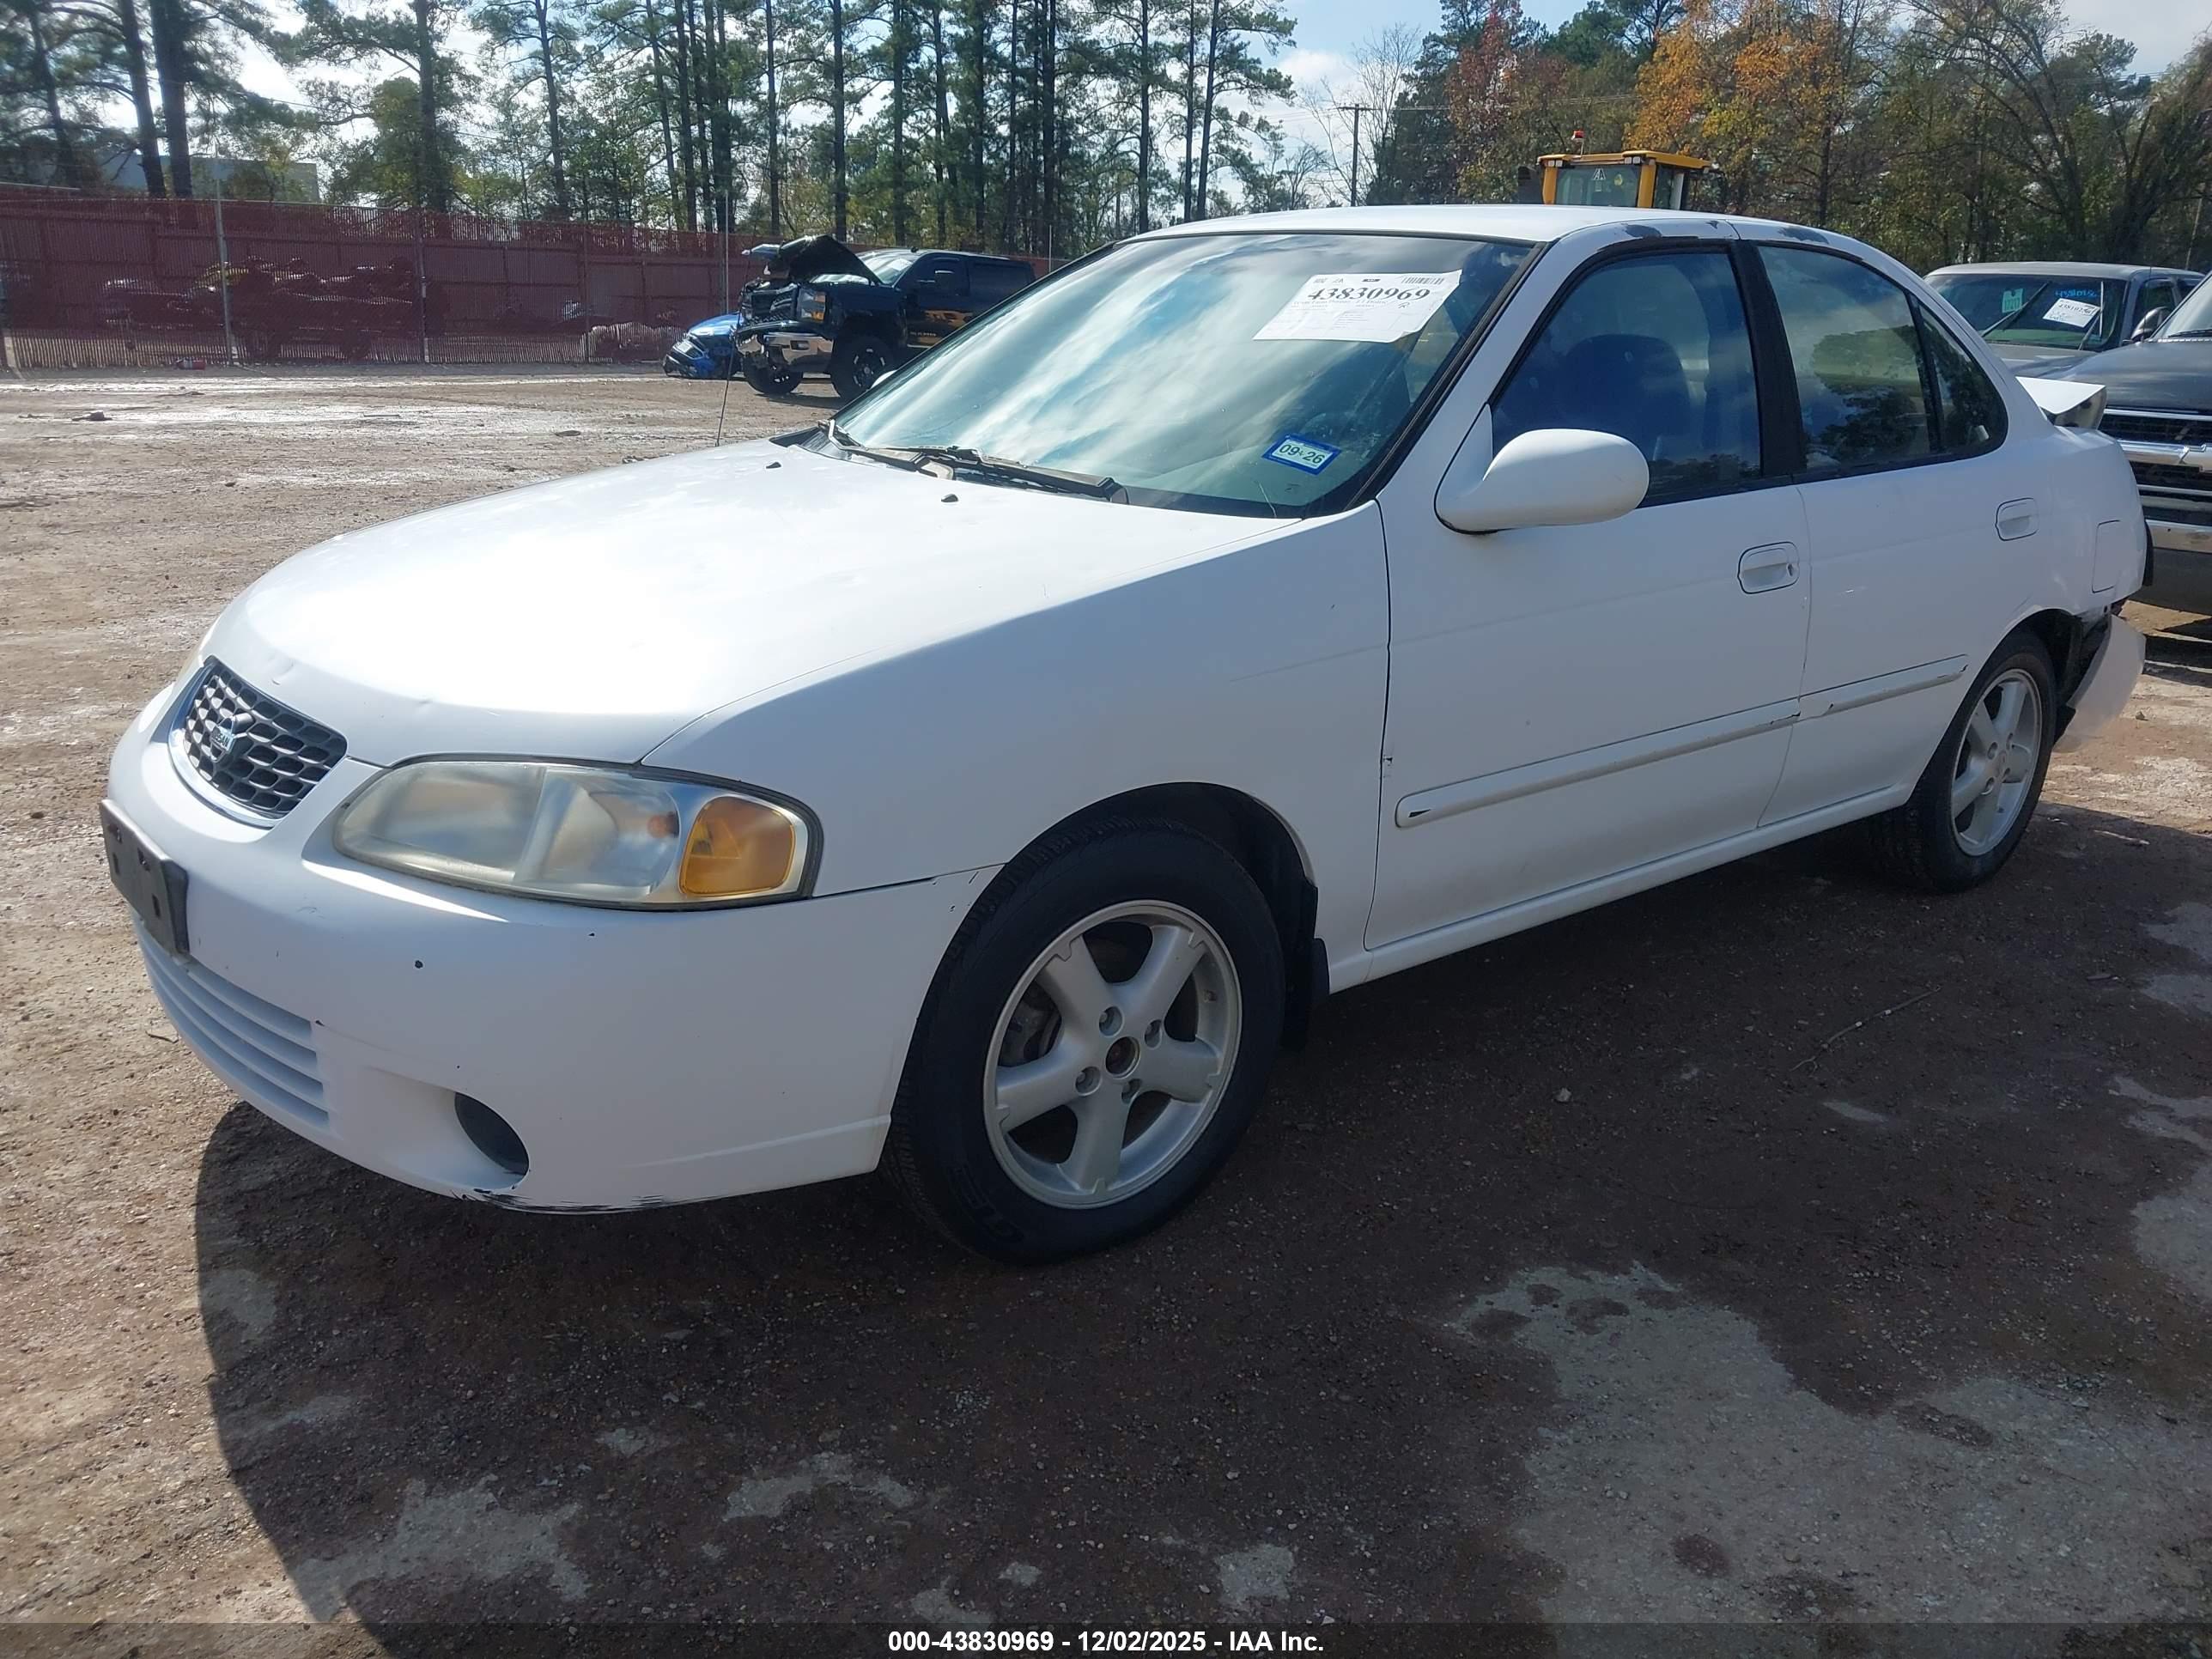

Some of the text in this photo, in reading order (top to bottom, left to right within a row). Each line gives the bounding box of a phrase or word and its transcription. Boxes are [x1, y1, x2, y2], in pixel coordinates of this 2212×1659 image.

[1308, 287, 1431, 301] 43830969
[1279, 444, 1326, 464] 09 26
